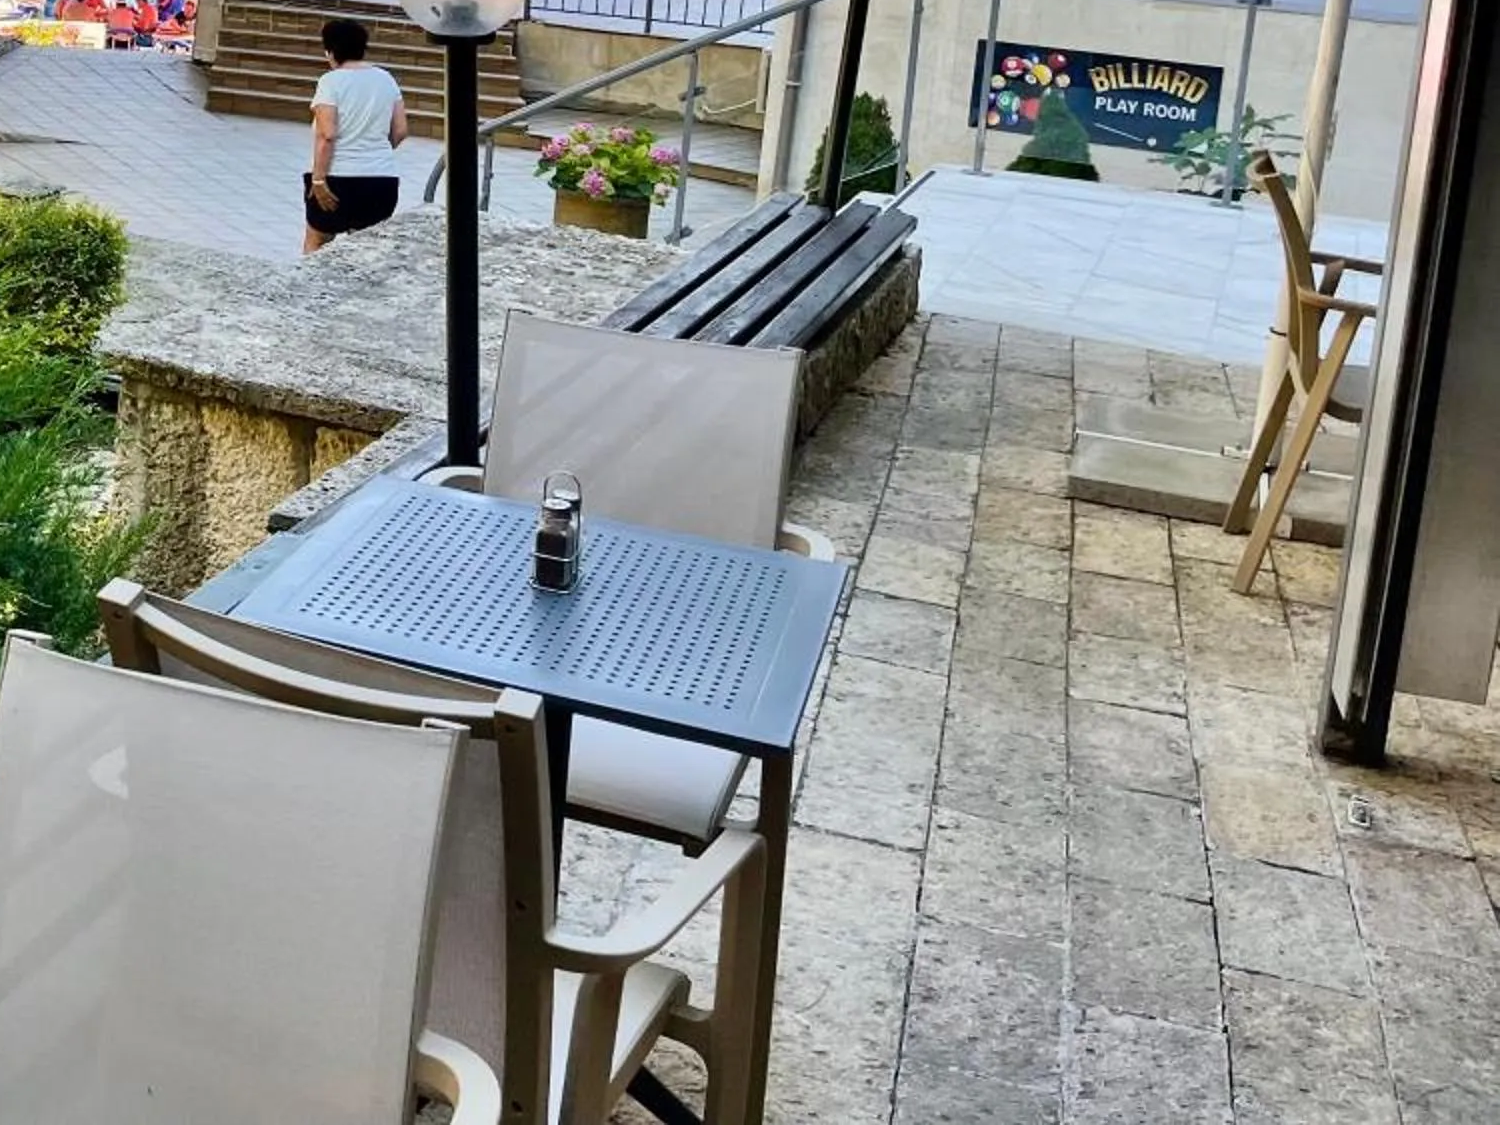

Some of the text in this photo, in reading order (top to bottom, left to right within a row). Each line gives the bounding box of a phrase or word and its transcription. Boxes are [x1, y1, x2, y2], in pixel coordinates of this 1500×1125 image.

[1089, 62, 1209, 104] BILLIARD
[1094, 96, 1197, 122] PLAY ROOM
